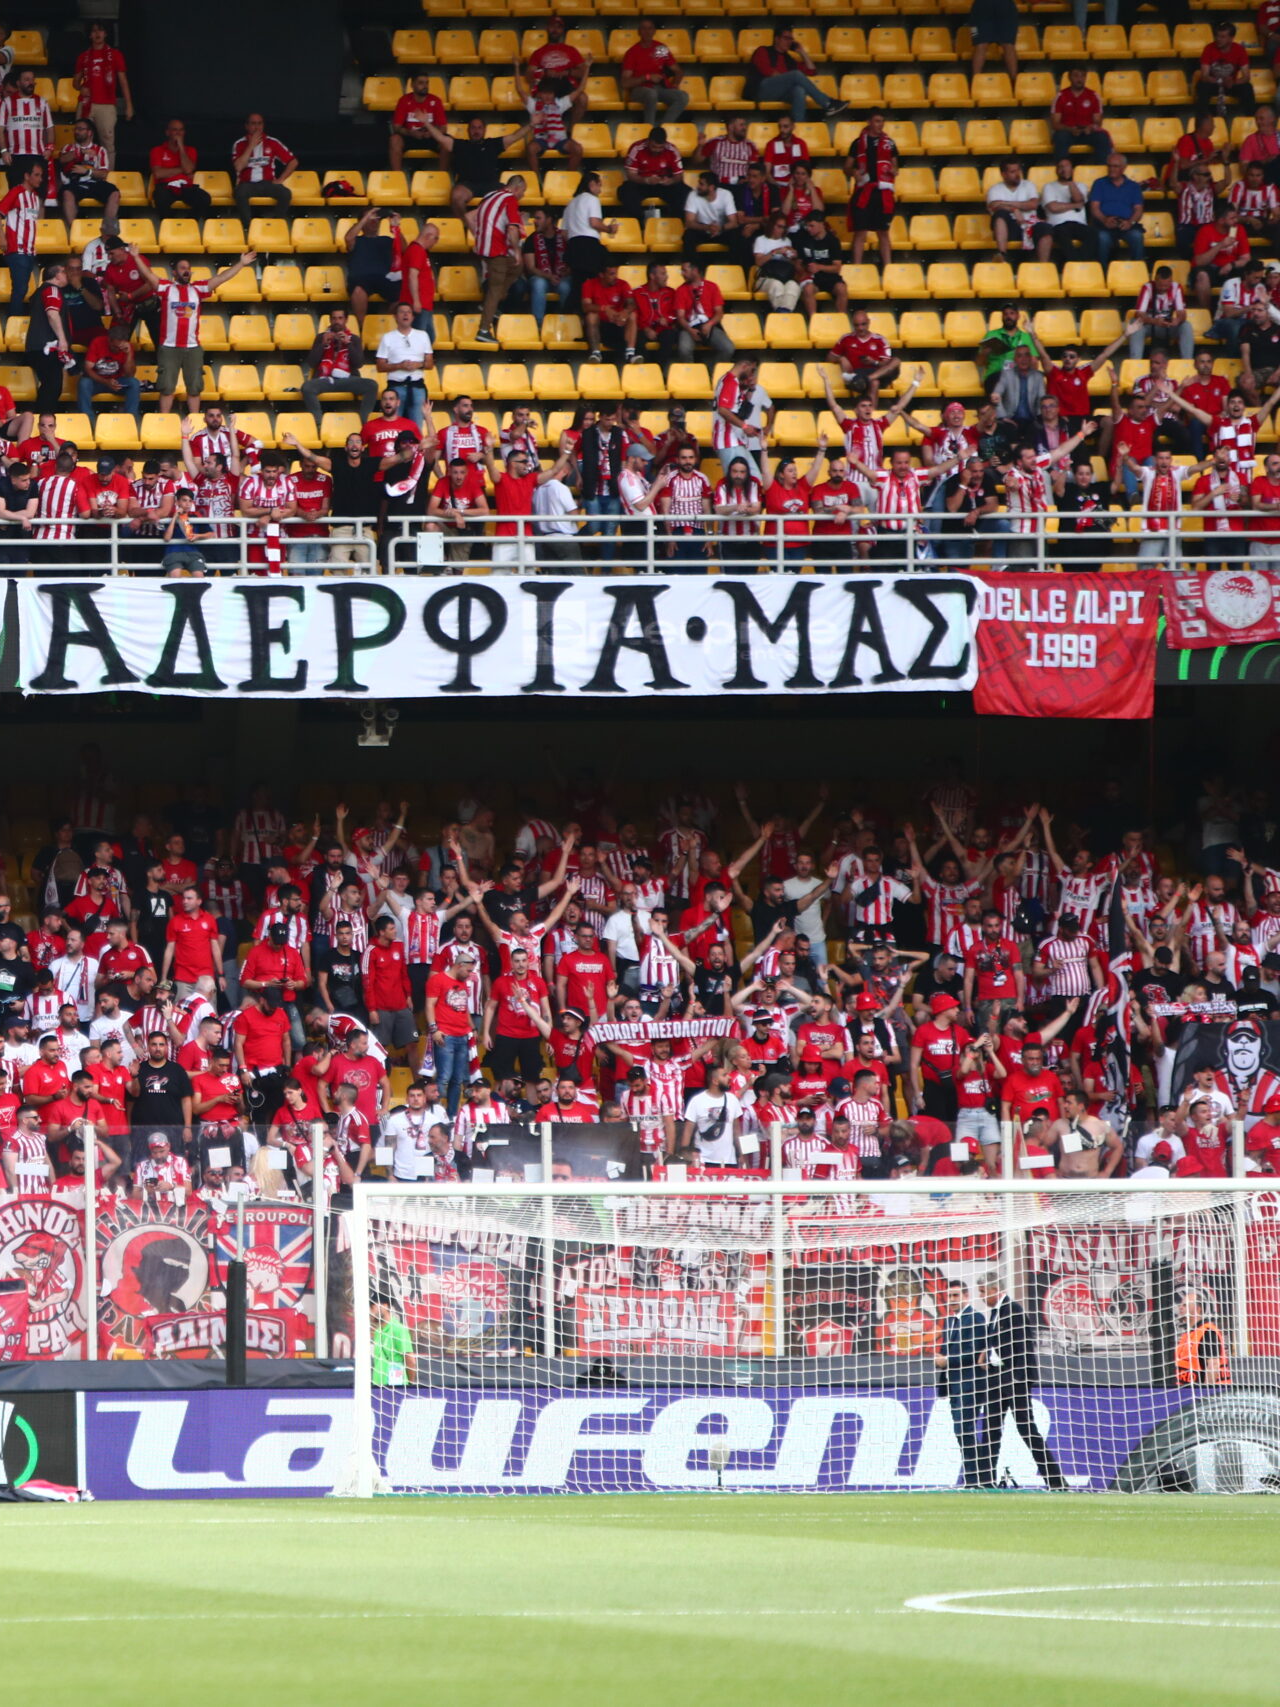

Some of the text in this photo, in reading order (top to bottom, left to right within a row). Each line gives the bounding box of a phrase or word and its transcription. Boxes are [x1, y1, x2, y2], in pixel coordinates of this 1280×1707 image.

[375, 430, 400, 442] FINA
[980, 587, 1145, 625] DELLE ALPI
[29, 581, 691, 692] ΑΔΕΡΦΙΑ
[713, 579, 978, 690] ΜΑΣ
[1024, 632, 1097, 669] 1999
[590, 1022, 645, 1045] ΝΕΟΧΩΡΙ
[1033, 1233, 1227, 1272] PASALIMANI
